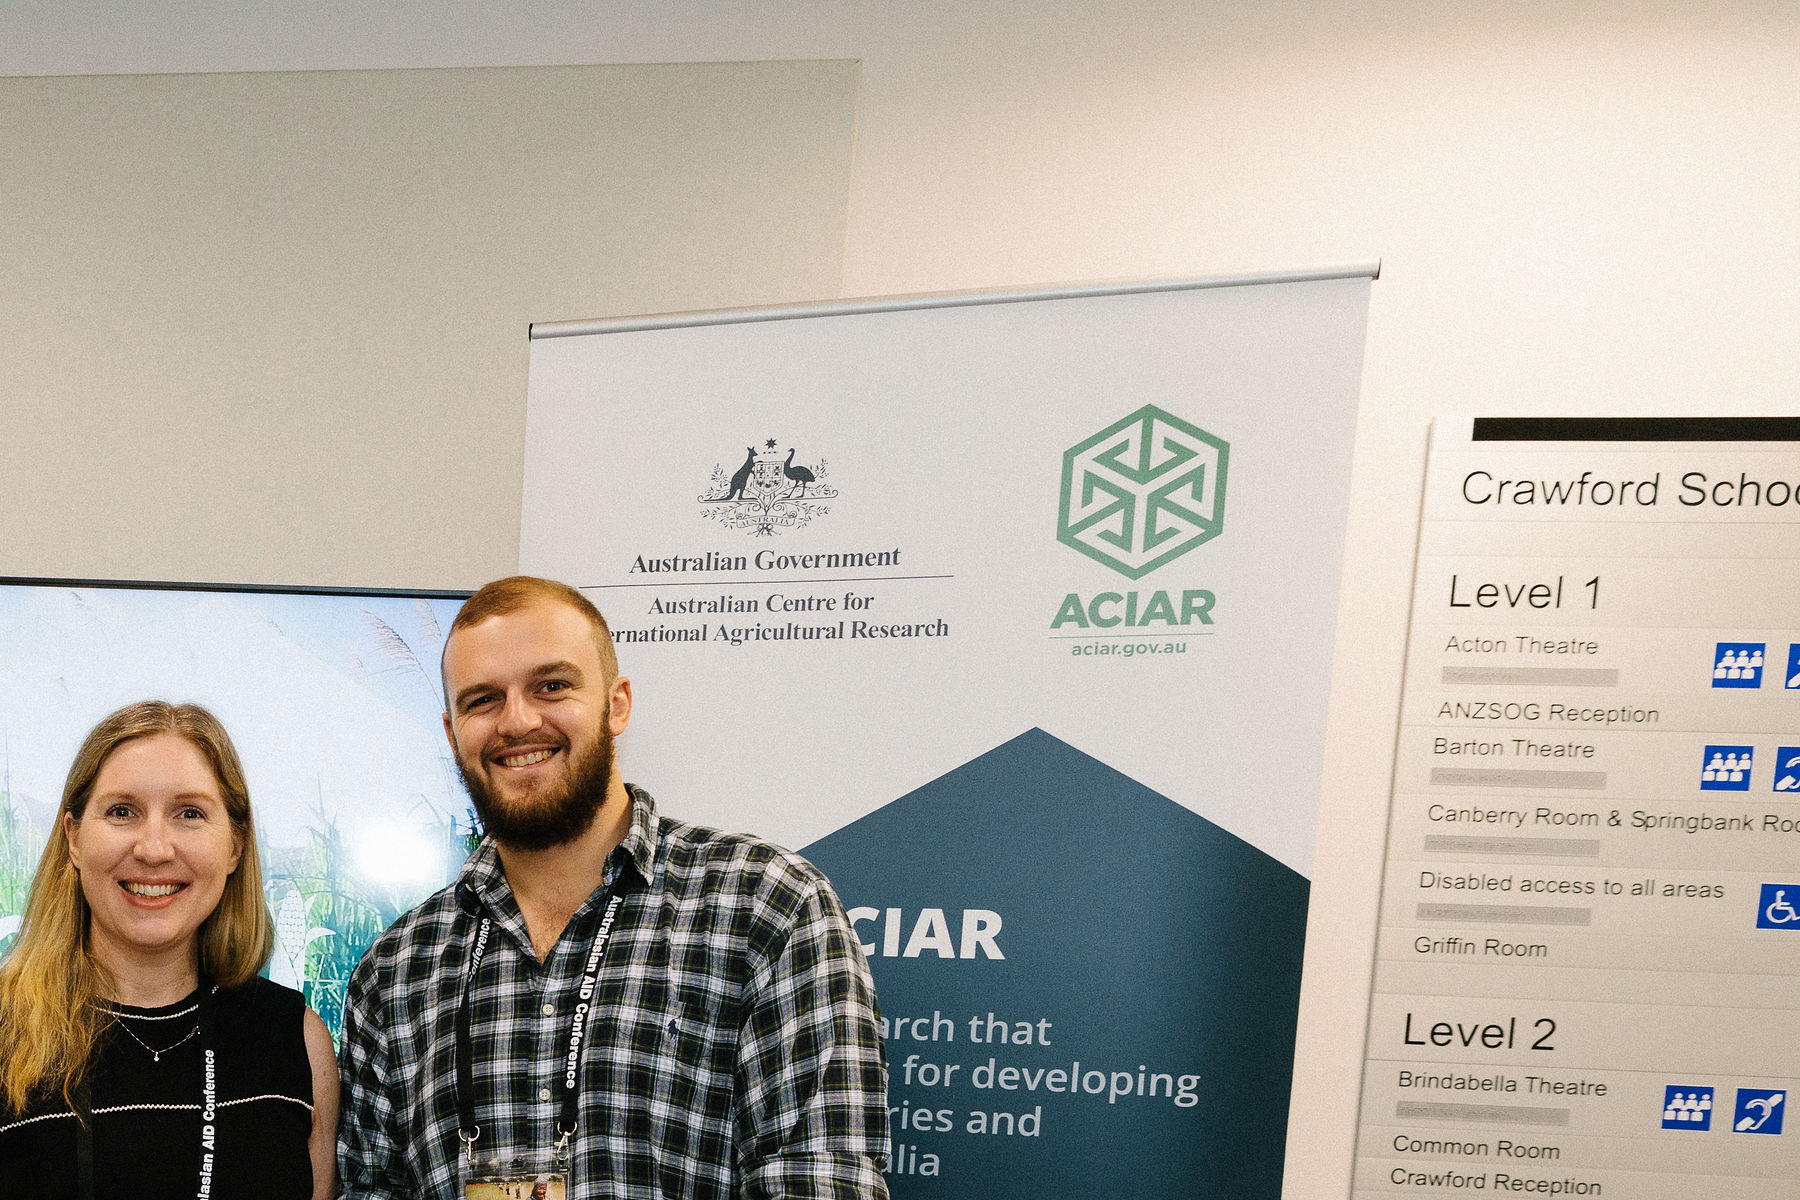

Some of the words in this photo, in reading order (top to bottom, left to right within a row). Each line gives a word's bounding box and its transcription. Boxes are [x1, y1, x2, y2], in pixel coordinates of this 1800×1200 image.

[1462, 470, 1660, 506] Crawford
[1678, 472, 1800, 508] Scho
[629, 551, 748, 573] Australian
[755, 546, 901, 571] Government
[648, 592, 759, 614] Australian
[766, 592, 836, 612] Centre
[843, 590, 874, 611] for
[1450, 574, 1563, 609] Level
[1584, 576, 1601, 609] 1
[1050, 589, 1216, 630] ACIAR
[611, 624, 707, 643] ernational
[712, 620, 845, 646] Agricultural
[851, 618, 949, 639] Research
[1445, 636, 1507, 654] Acton
[1515, 637, 1598, 655] Theatre
[1071, 639, 1186, 658] aciar.gov.au
[1438, 702, 1541, 722] ANZSOG
[1550, 704, 1659, 723] Reception
[1433, 738, 1504, 757] Barton
[1512, 740, 1595, 758] Theatre
[1427, 805, 1527, 828] Canberry
[1535, 808, 1599, 826] Room
[1607, 810, 1622, 827] &
[1631, 811, 1754, 834] Springbank
[1419, 872, 1512, 892] Disabled
[1520, 878, 1595, 895] access
[1604, 877, 1623, 895] to
[1631, 878, 1654, 897] all
[1662, 882, 1725, 898] areas
[584, 895, 622, 973] Australasian
[850, 907, 1005, 960] CIAR
[1414, 936, 1476, 955] Griffin
[1484, 939, 1547, 957] Room
[579, 975, 596, 1000] AID
[969, 1012, 1052, 1046] that
[1404, 1013, 1516, 1049] Level
[1531, 1018, 1556, 1051] 2
[566, 1003, 589, 1089] Conference
[203, 1049, 214, 1121] Conference
[903, 1055, 960, 1087] for
[972, 1059, 1201, 1108] developing
[1399, 1071, 1518, 1093] Brindabella
[1526, 1077, 1608, 1096] Theatre
[967, 1106, 1041, 1137] and
[202, 1125, 214, 1150] AID
[1393, 1136, 1489, 1156] Common
[1498, 1141, 1560, 1160] Room
[1390, 1168, 1486, 1189] Crawford
[1494, 1174, 1602, 1196] Reception
